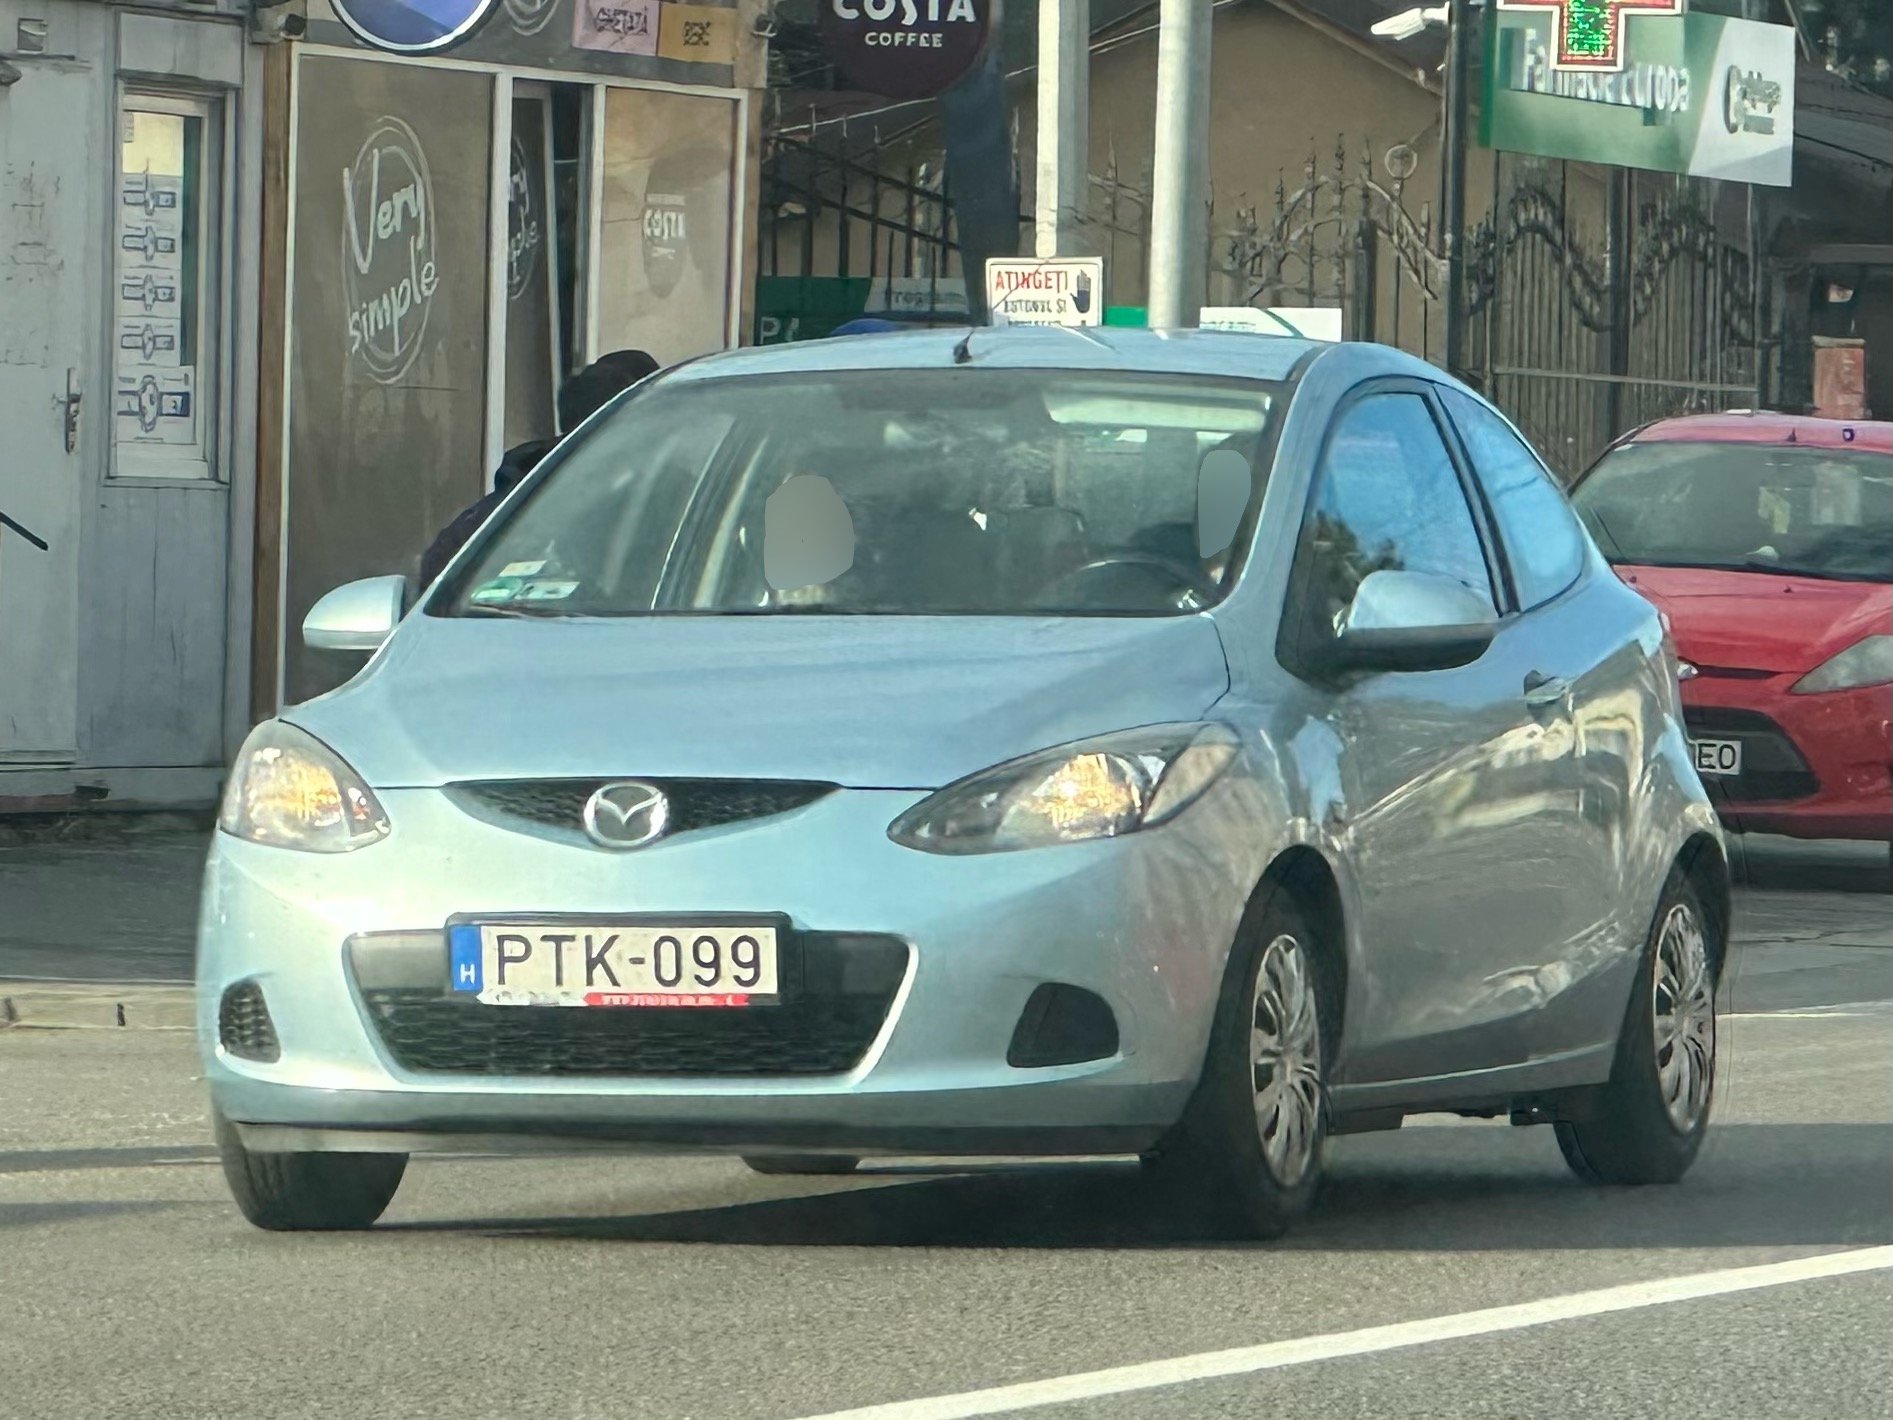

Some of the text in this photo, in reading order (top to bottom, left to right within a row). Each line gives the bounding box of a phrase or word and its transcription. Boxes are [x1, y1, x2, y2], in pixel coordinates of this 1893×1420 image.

[864, 31, 943, 48] COFFEE
[343, 148, 426, 274] Very
[350, 235, 440, 355] simple
[1697, 743, 1736, 770] EO
[459, 963, 476, 984] H
[496, 934, 761, 988] PTK-099
